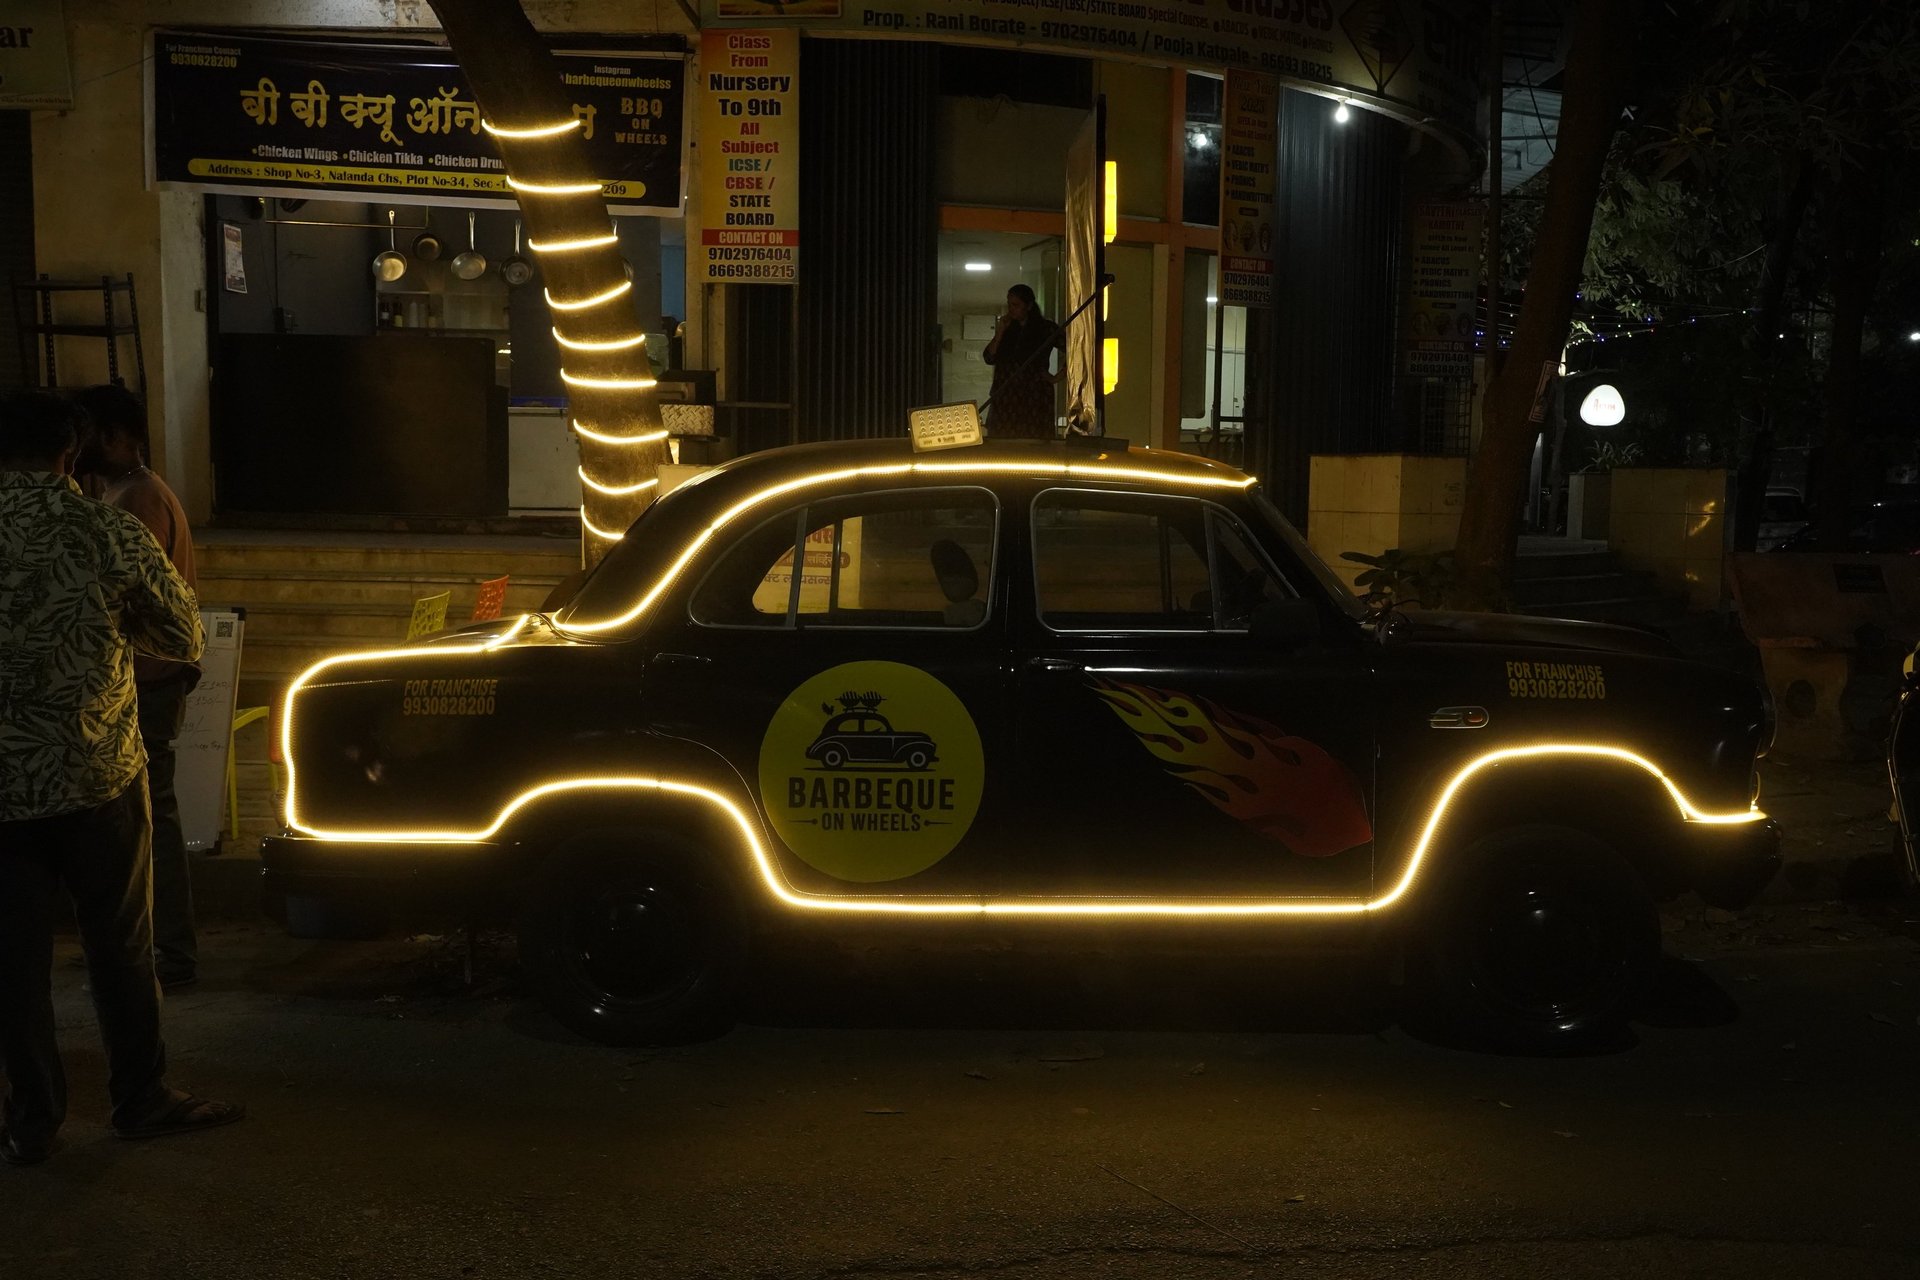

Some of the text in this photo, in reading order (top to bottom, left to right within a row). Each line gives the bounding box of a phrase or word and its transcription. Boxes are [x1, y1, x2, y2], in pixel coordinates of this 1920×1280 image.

[1119, 3, 1146, 19] BOARD
[1148, 7, 1177, 24] Special
[1226, 0, 1333, 31] asses
[728, 35, 771, 49] Class
[863, 10, 910, 29] Prop.
[926, 12, 964, 31] Rani
[969, 16, 1026, 35] Borate
[1041, 21, 1137, 47] 9702976404
[1154, 35, 1194, 56] Pooja
[1197, 42, 1250, 66] Katpale
[170, 53, 238, 68] 9930828200
[731, 54, 769, 67] From
[594, 64, 632, 76] Instagram
[709, 73, 791, 93] Nursery
[240, 76, 281, 127] बी
[289, 79, 331, 129] बी
[338, 93, 404, 147] क्यू
[620, 97, 664, 120] BBQ
[718, 98, 782, 116] To 9th
[631, 118, 651, 131] ON
[740, 122, 760, 135] All
[614, 131, 668, 146] WHEELS
[721, 140, 780, 154] Subject
[257, 145, 302, 160] Chicken
[304, 147, 339, 162] Wings
[348, 149, 392, 164] Chicken
[394, 151, 424, 165] Tikka
[434, 154, 478, 169] Chicken
[728, 158, 762, 172] ICSE
[208, 163, 253, 176] Address
[263, 164, 293, 179] Shop
[295, 166, 325, 181] No-3,
[328, 170, 375, 183] Nalanda
[378, 172, 402, 185] Chs,
[406, 174, 429, 186] Plot
[473, 178, 494, 189] Sec
[725, 176, 763, 190] CBSE
[729, 194, 771, 208] STATE
[725, 212, 775, 226] BOARD
[719, 231, 784, 245] CONTACT ON
[708, 247, 792, 261] 9702976404
[708, 264, 795, 278] 8669388215
[1506, 660, 1604, 682] FOR FRANCHISE
[404, 679, 498, 697] FOR FRANCHISE
[1508, 678, 1606, 700] 9930828200
[402, 696, 496, 716] 9930828200
[788, 777, 955, 814] BARBEQUE
[821, 813, 921, 832] ON WHEELS
